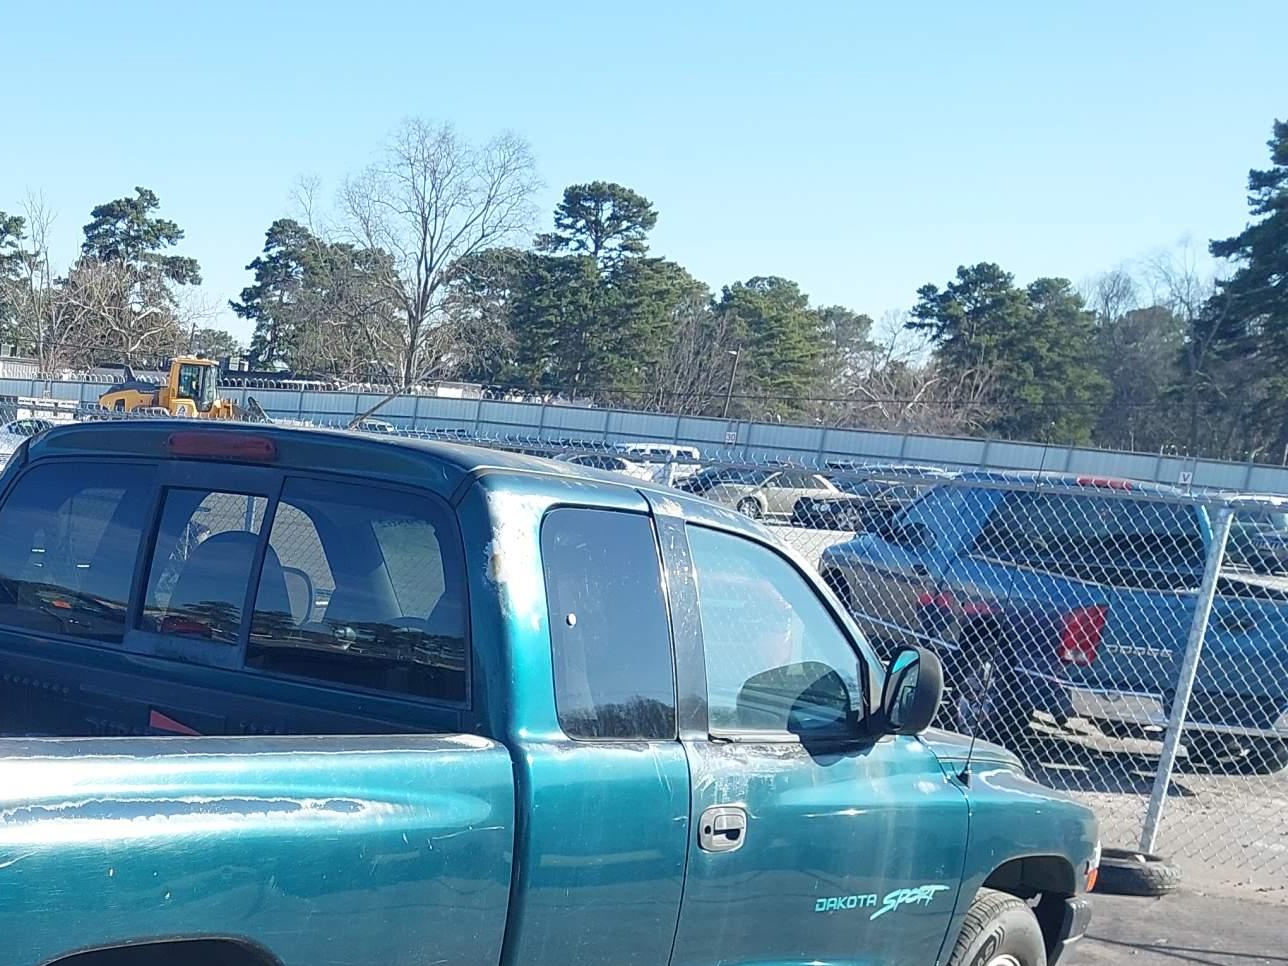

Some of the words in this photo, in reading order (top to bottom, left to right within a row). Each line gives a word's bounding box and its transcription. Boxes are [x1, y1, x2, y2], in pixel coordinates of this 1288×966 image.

[1106, 644, 1173, 658] DODGE
[815, 893, 878, 912] DAKOTA
[869, 884, 950, 921] SPORT
